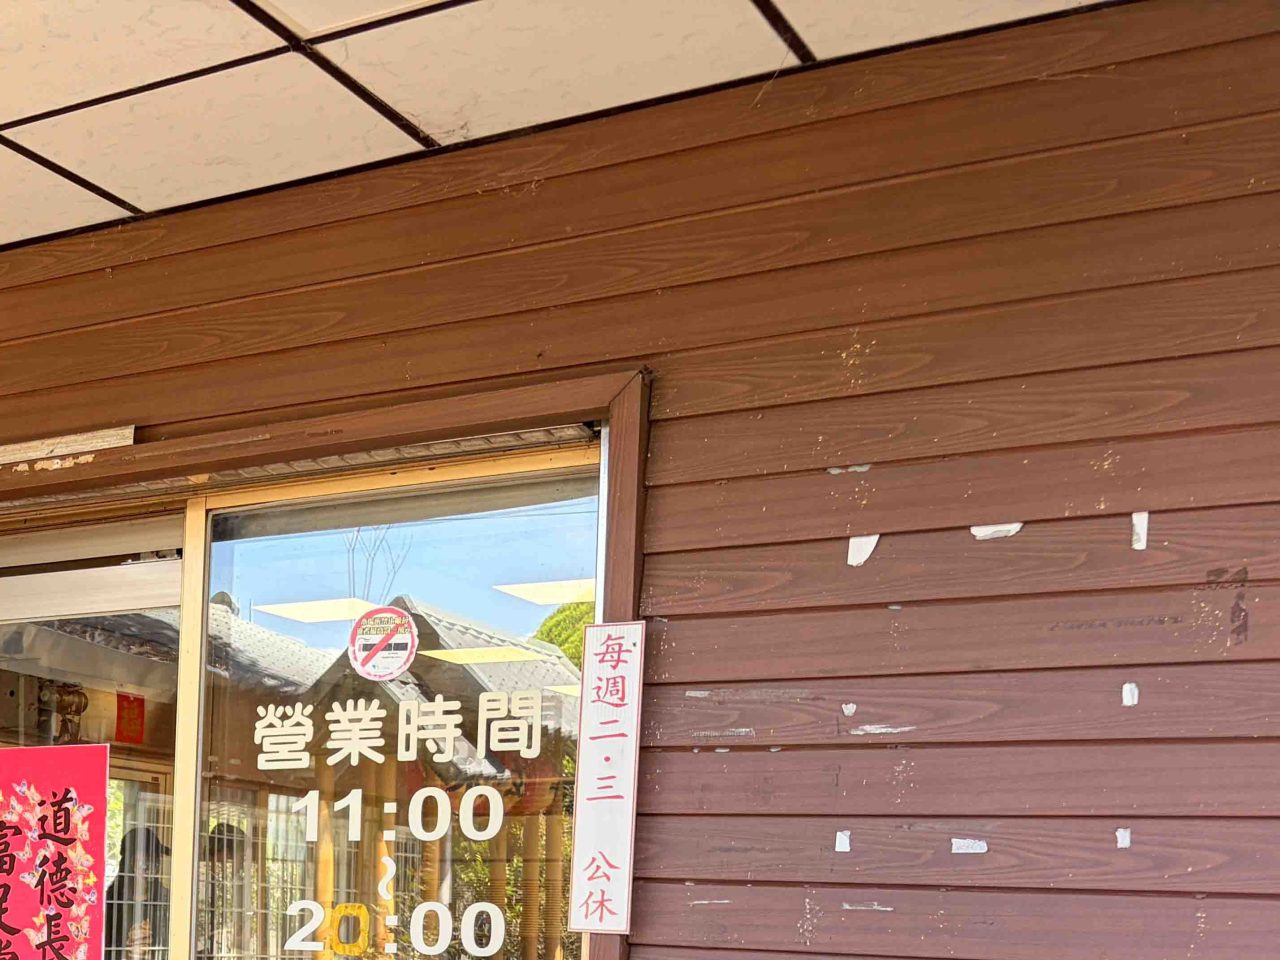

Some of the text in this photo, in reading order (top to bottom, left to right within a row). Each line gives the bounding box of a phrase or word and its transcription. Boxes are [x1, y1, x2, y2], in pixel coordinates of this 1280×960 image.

[253, 689, 542, 771] 營業時間
[290, 785, 505, 842] 11:00
[284, 900, 506, 957] 20:00
